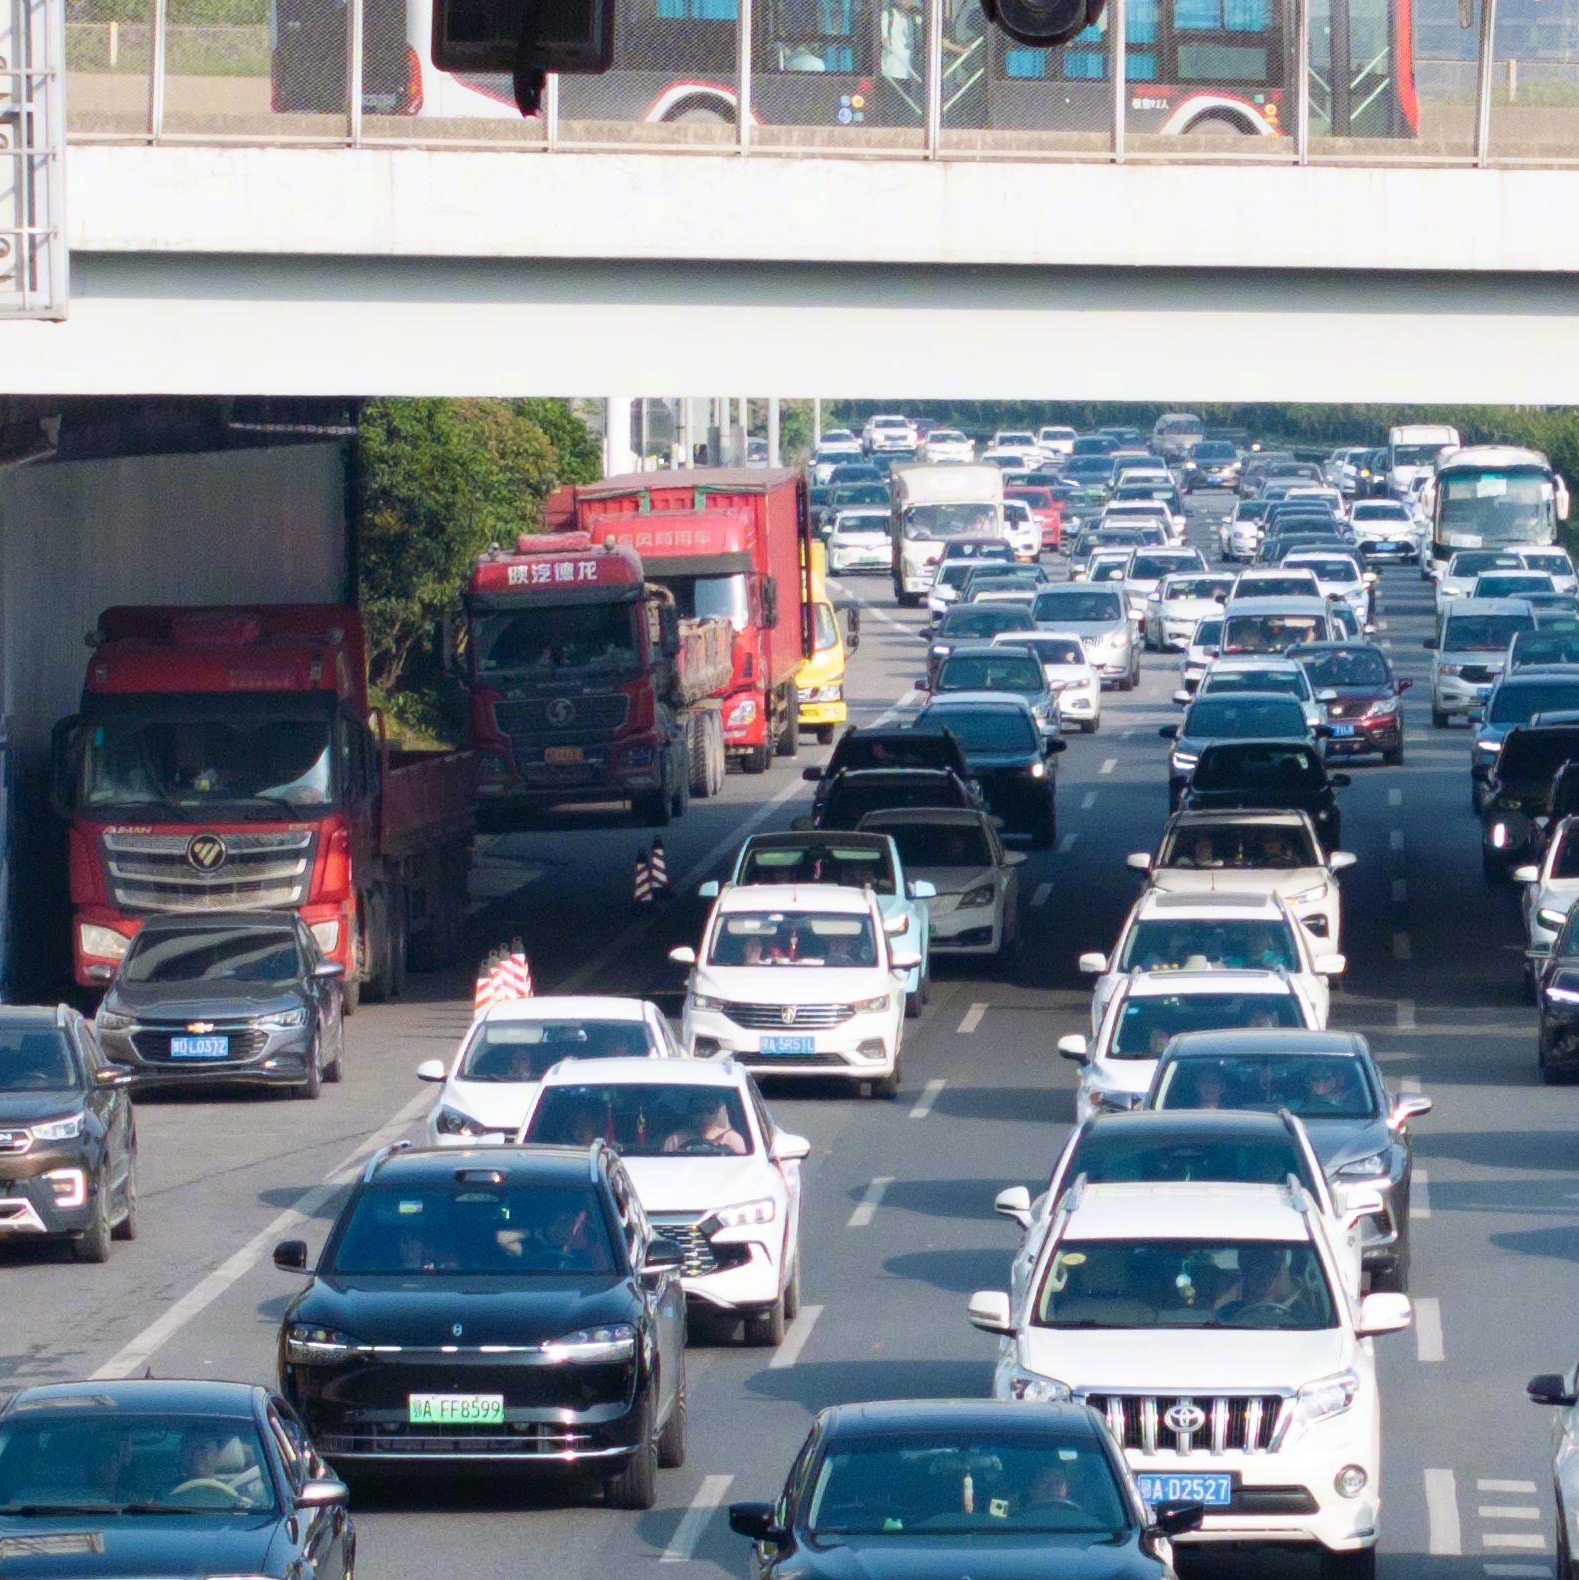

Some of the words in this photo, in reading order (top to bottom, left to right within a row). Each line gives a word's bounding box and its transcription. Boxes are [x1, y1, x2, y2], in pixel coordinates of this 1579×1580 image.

[507, 561, 598, 586] 陕汽德龙
[441, 1400, 501, 1419] FF8599
